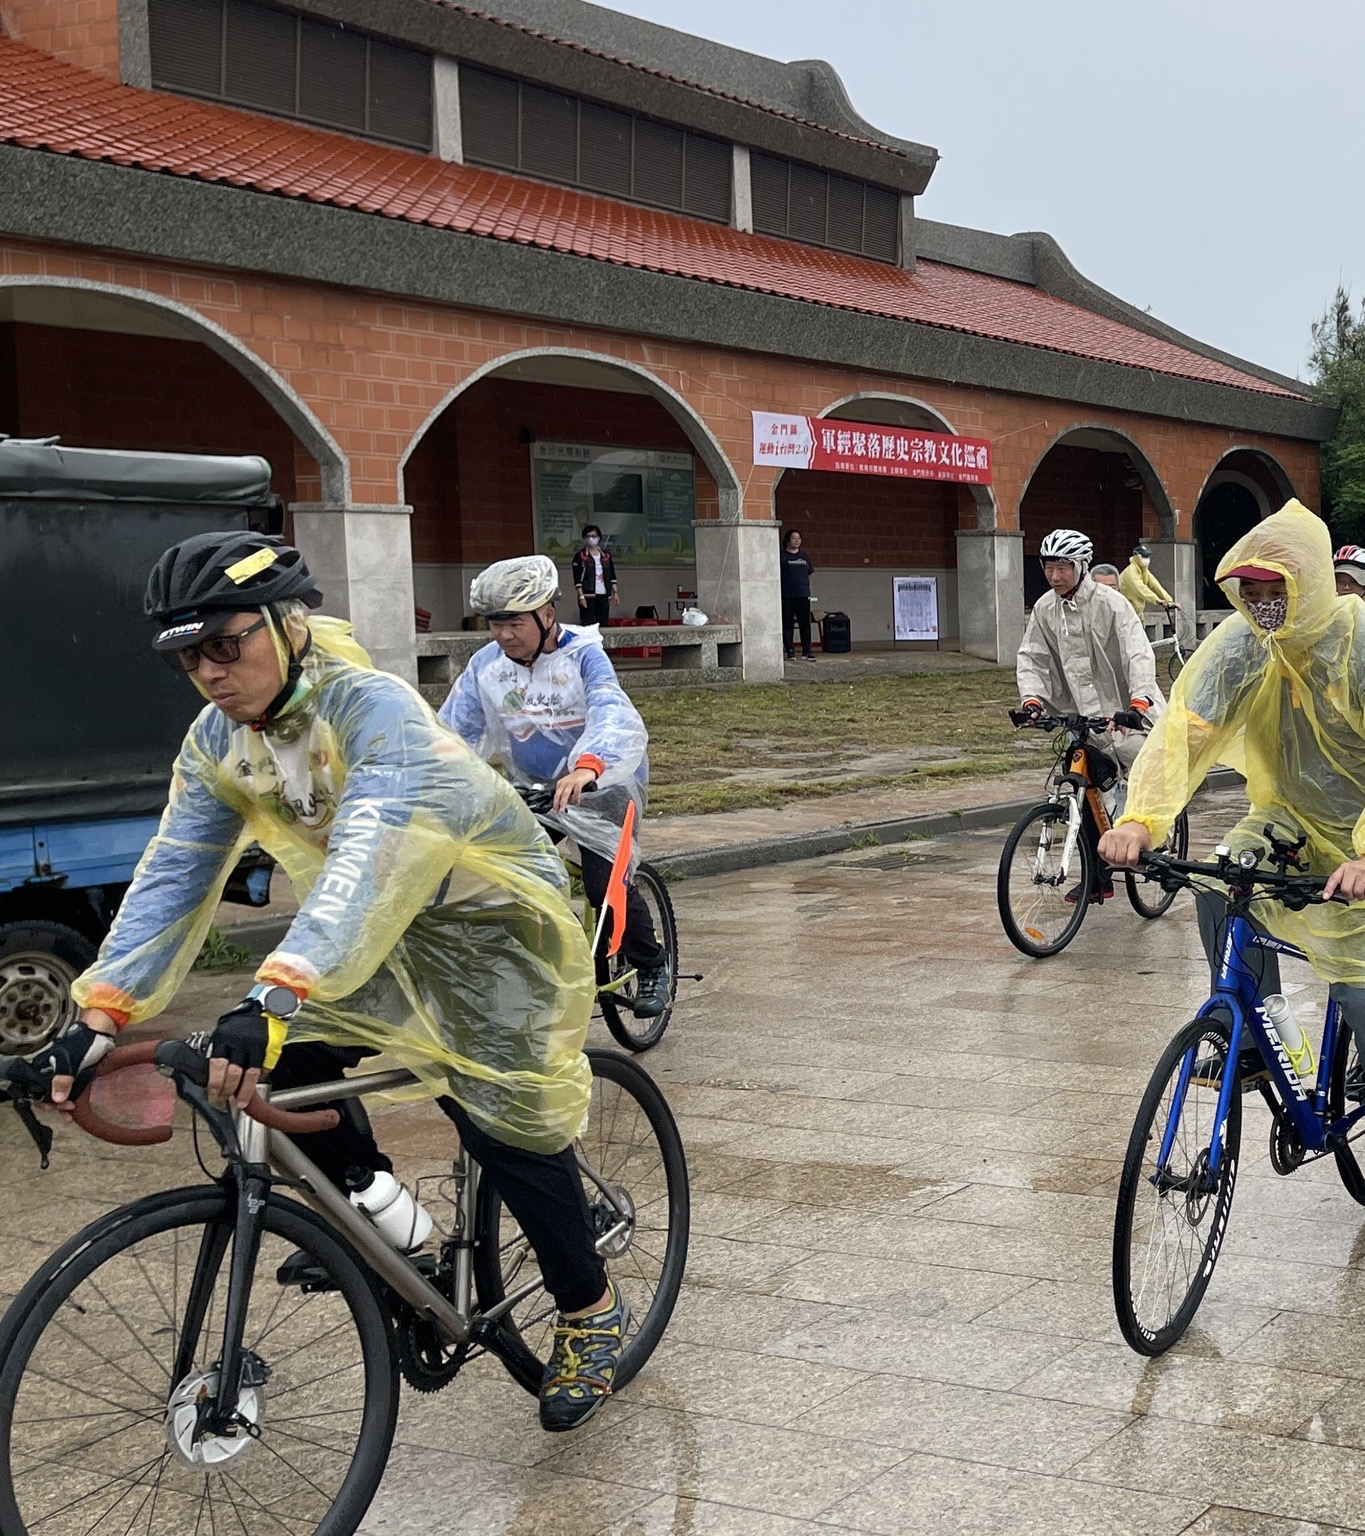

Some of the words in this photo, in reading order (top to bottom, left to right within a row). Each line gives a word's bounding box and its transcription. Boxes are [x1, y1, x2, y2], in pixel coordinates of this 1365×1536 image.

[771, 422, 798, 436] 金門縣
[821, 427, 989, 470] 軍經聚落歷史宗教文化巡禮
[310, 799, 384, 925] KINMEN
[1255, 1005, 1309, 1102] MERIDA
